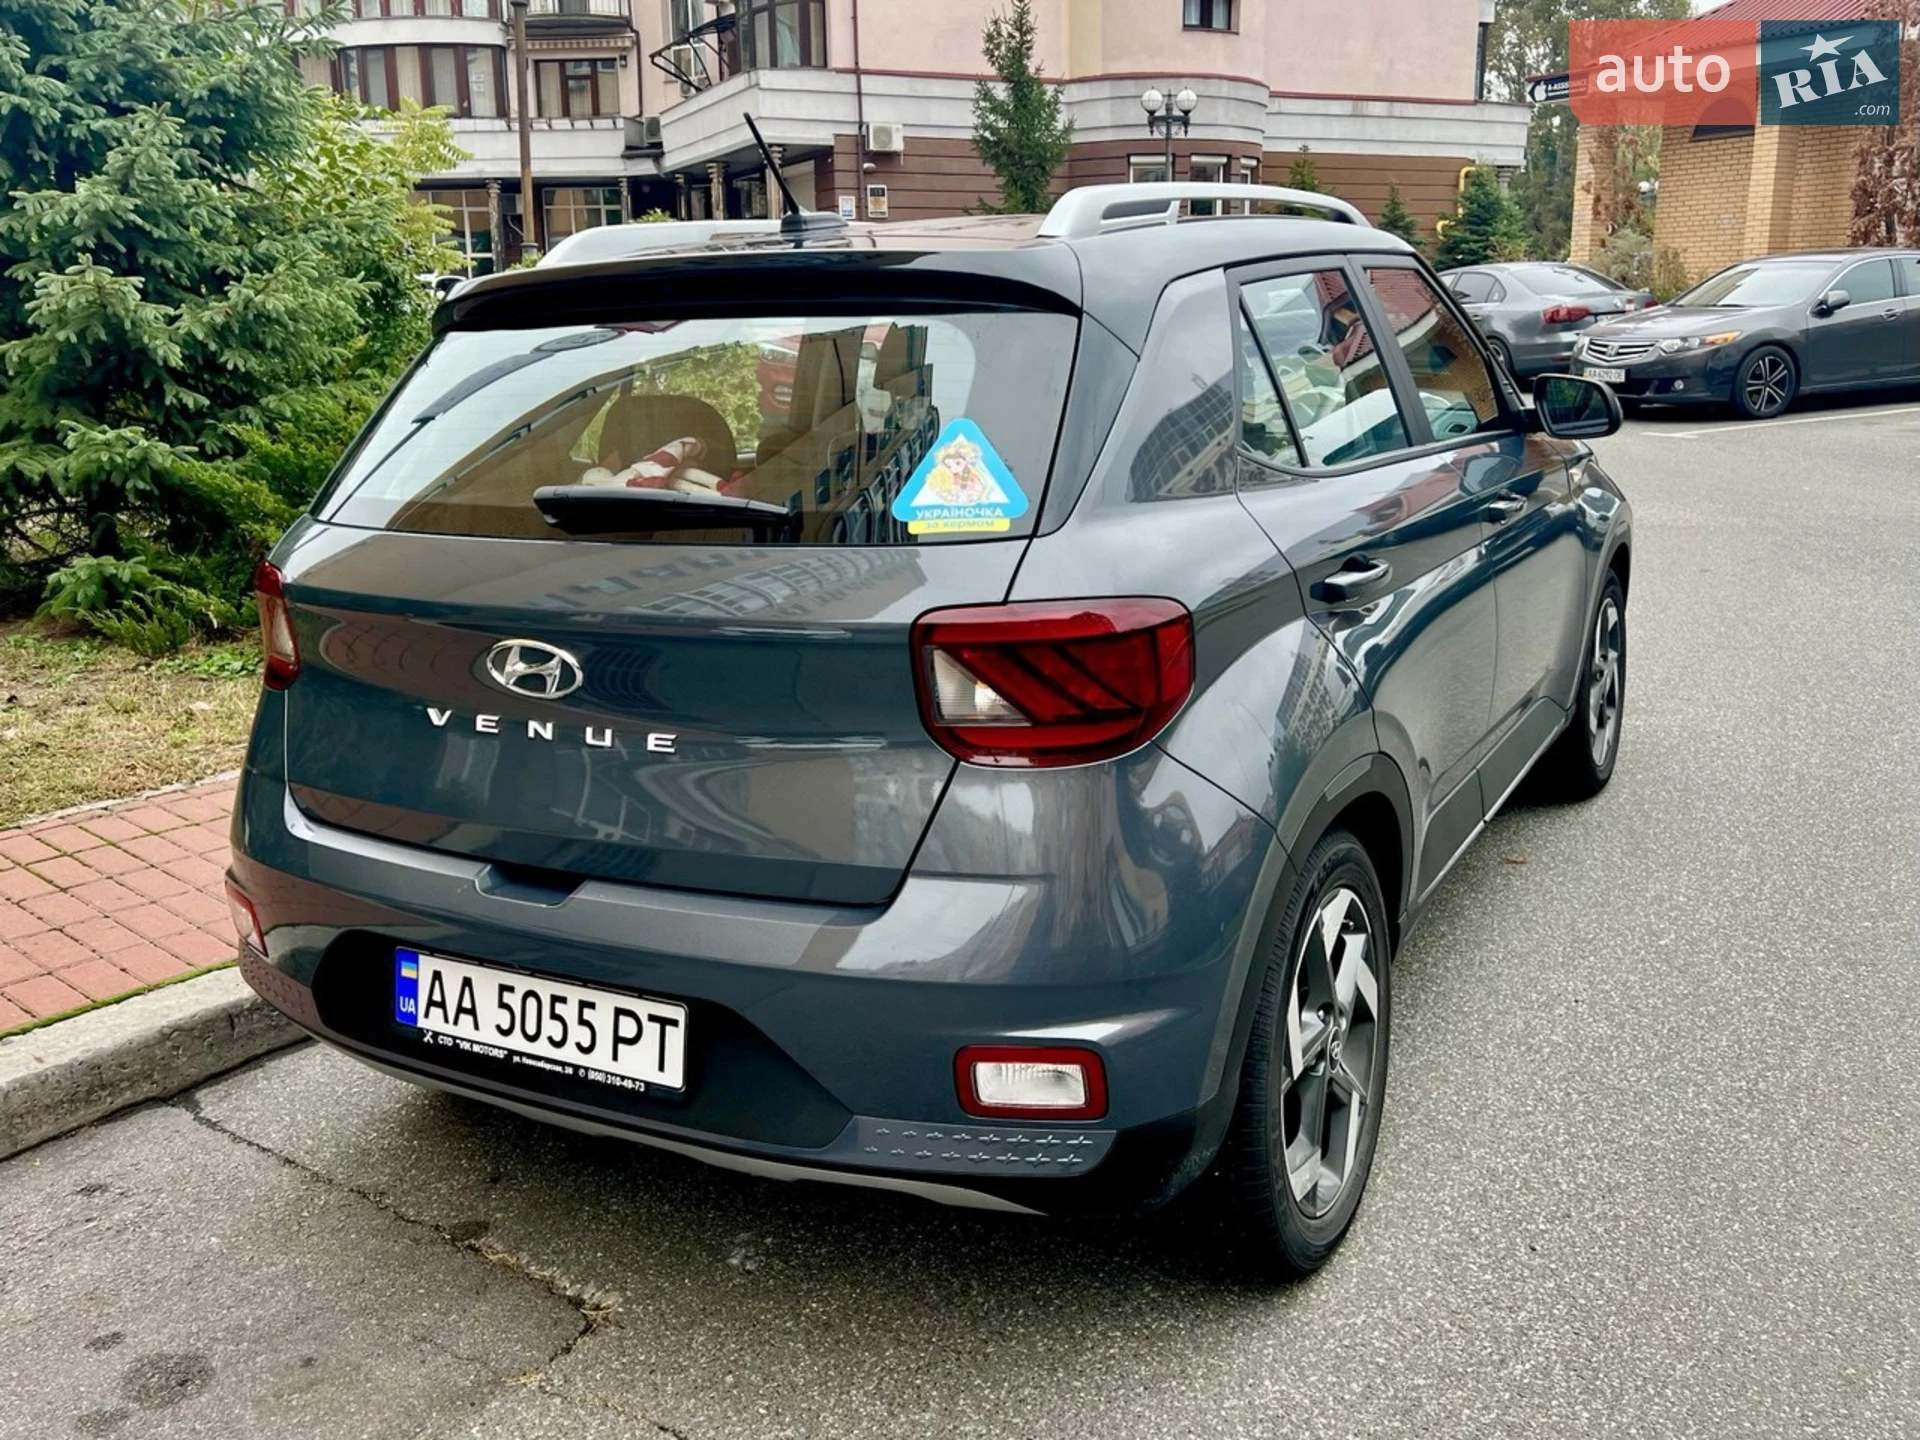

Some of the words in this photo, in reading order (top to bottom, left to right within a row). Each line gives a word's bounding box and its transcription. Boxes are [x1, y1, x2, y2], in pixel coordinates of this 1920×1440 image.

[916, 507, 1004, 520] УКРАЇНОЧКА
[427, 707, 677, 753] VENUE
[400, 996, 416, 1015] UA
[424, 970, 480, 1031] AA
[495, 983, 597, 1055] 5055
[612, 1006, 680, 1073] PT
